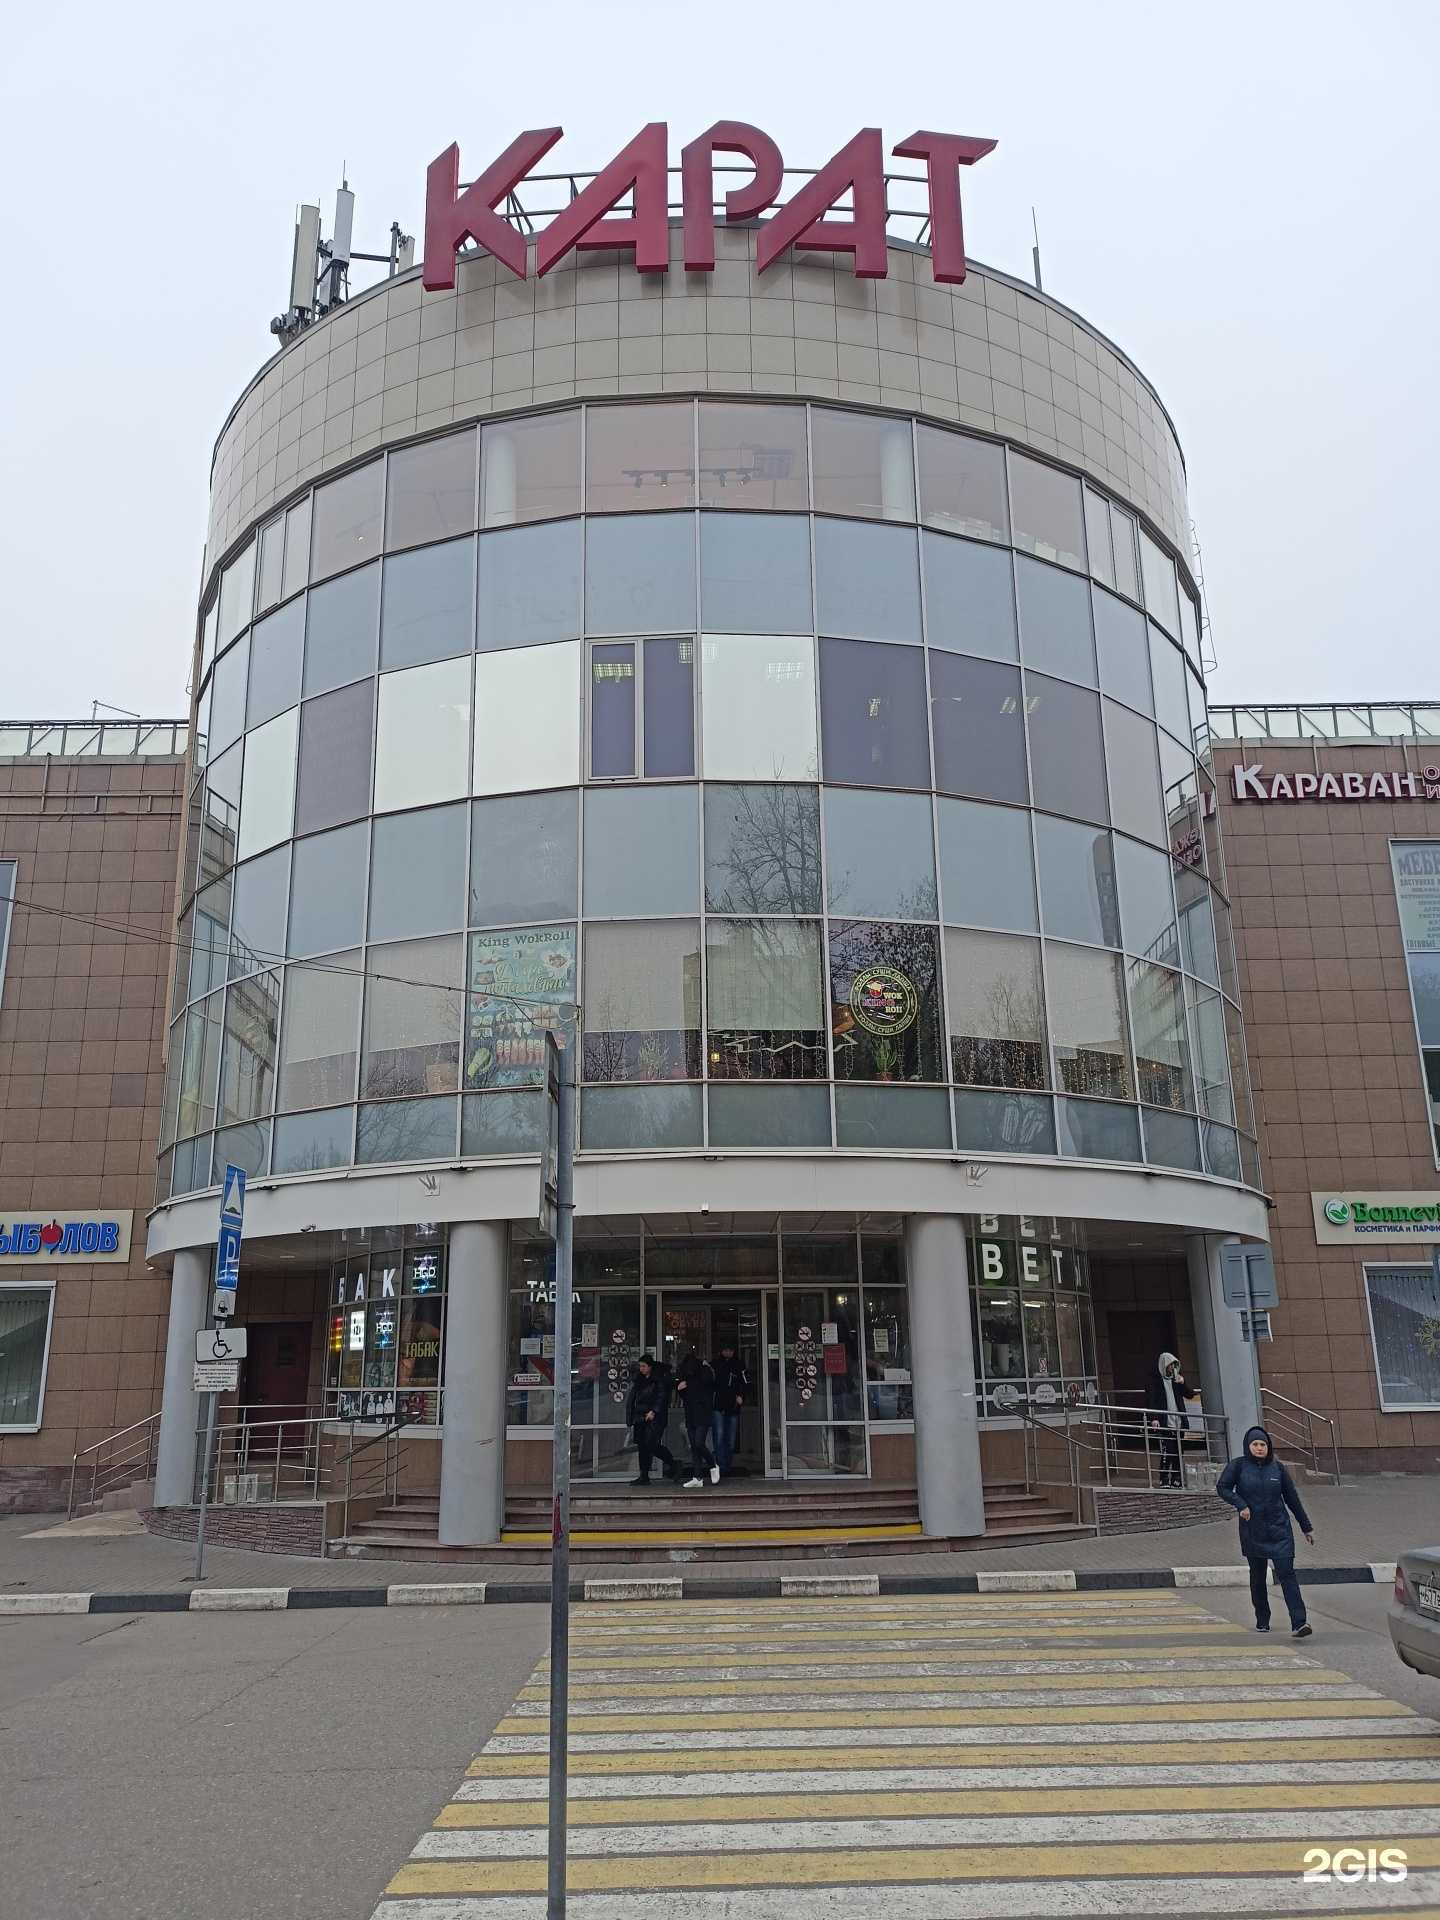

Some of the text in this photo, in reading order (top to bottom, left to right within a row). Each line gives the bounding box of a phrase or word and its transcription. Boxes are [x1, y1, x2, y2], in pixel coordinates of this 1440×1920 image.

[423, 120, 998, 292] КАРАТ
[1233, 764, 1417, 799] КАРАВАН
[479, 937, 510, 948] King
[1354, 1225, 1404, 1233] КОСМЕТИКА
